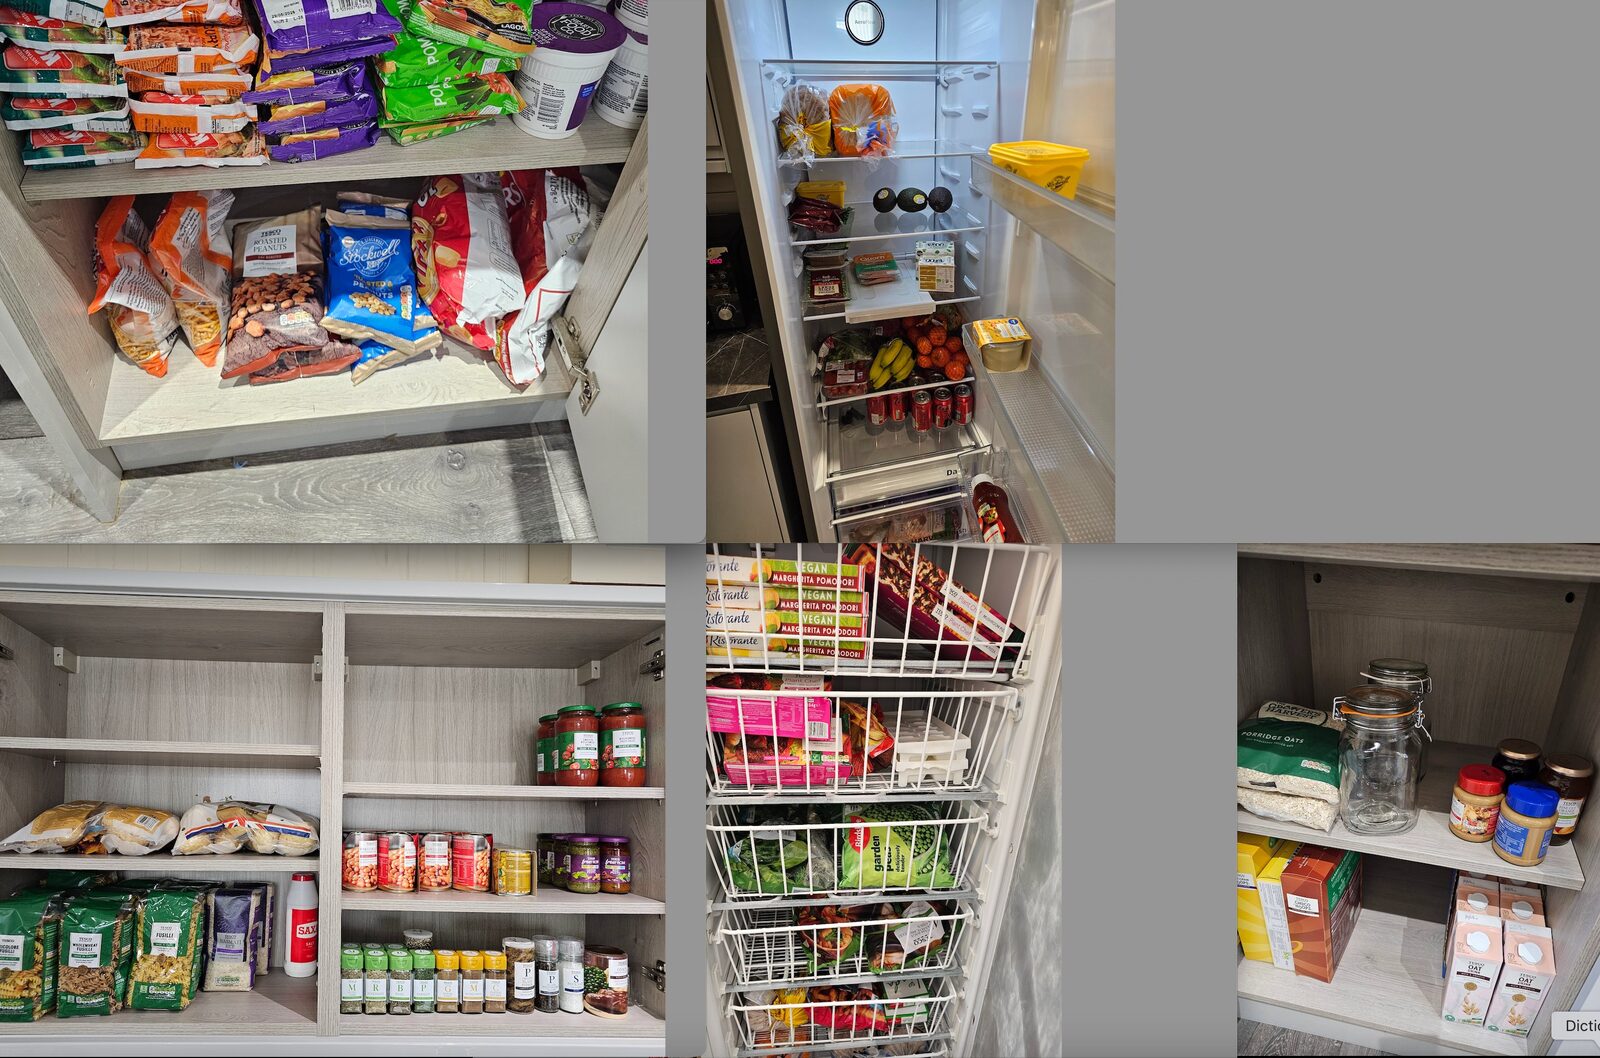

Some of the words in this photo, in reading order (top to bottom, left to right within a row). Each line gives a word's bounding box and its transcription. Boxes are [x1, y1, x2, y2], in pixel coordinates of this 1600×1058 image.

[559, 19, 592, 36] FOOD
[261, 229, 281, 237] TESCO
[254, 237, 287, 245] ROASTED
[254, 244, 287, 252] PEANUTS
[340, 239, 400, 266] Stockwell
[795, 561, 828, 573] VEGAN
[773, 574, 814, 583] MARGHRITA
[801, 591, 833, 600] VEGAN
[780, 602, 820, 610] MARGERITA
[802, 614, 833, 625] VEGAN
[781, 625, 820, 634] MARGERITA
[827, 649, 860, 658] POODORI
[1241, 731, 1282, 741] PORRIDGE
[1284, 736, 1304, 744] OATS
[871, 835, 884, 872] garden
[298, 925, 317, 935] SAX
[525, 968, 531, 977] P
[549, 976, 556, 984] P
[573, 975, 580, 983] S
[373, 984, 379, 992] R
[445, 985, 452, 993] G
